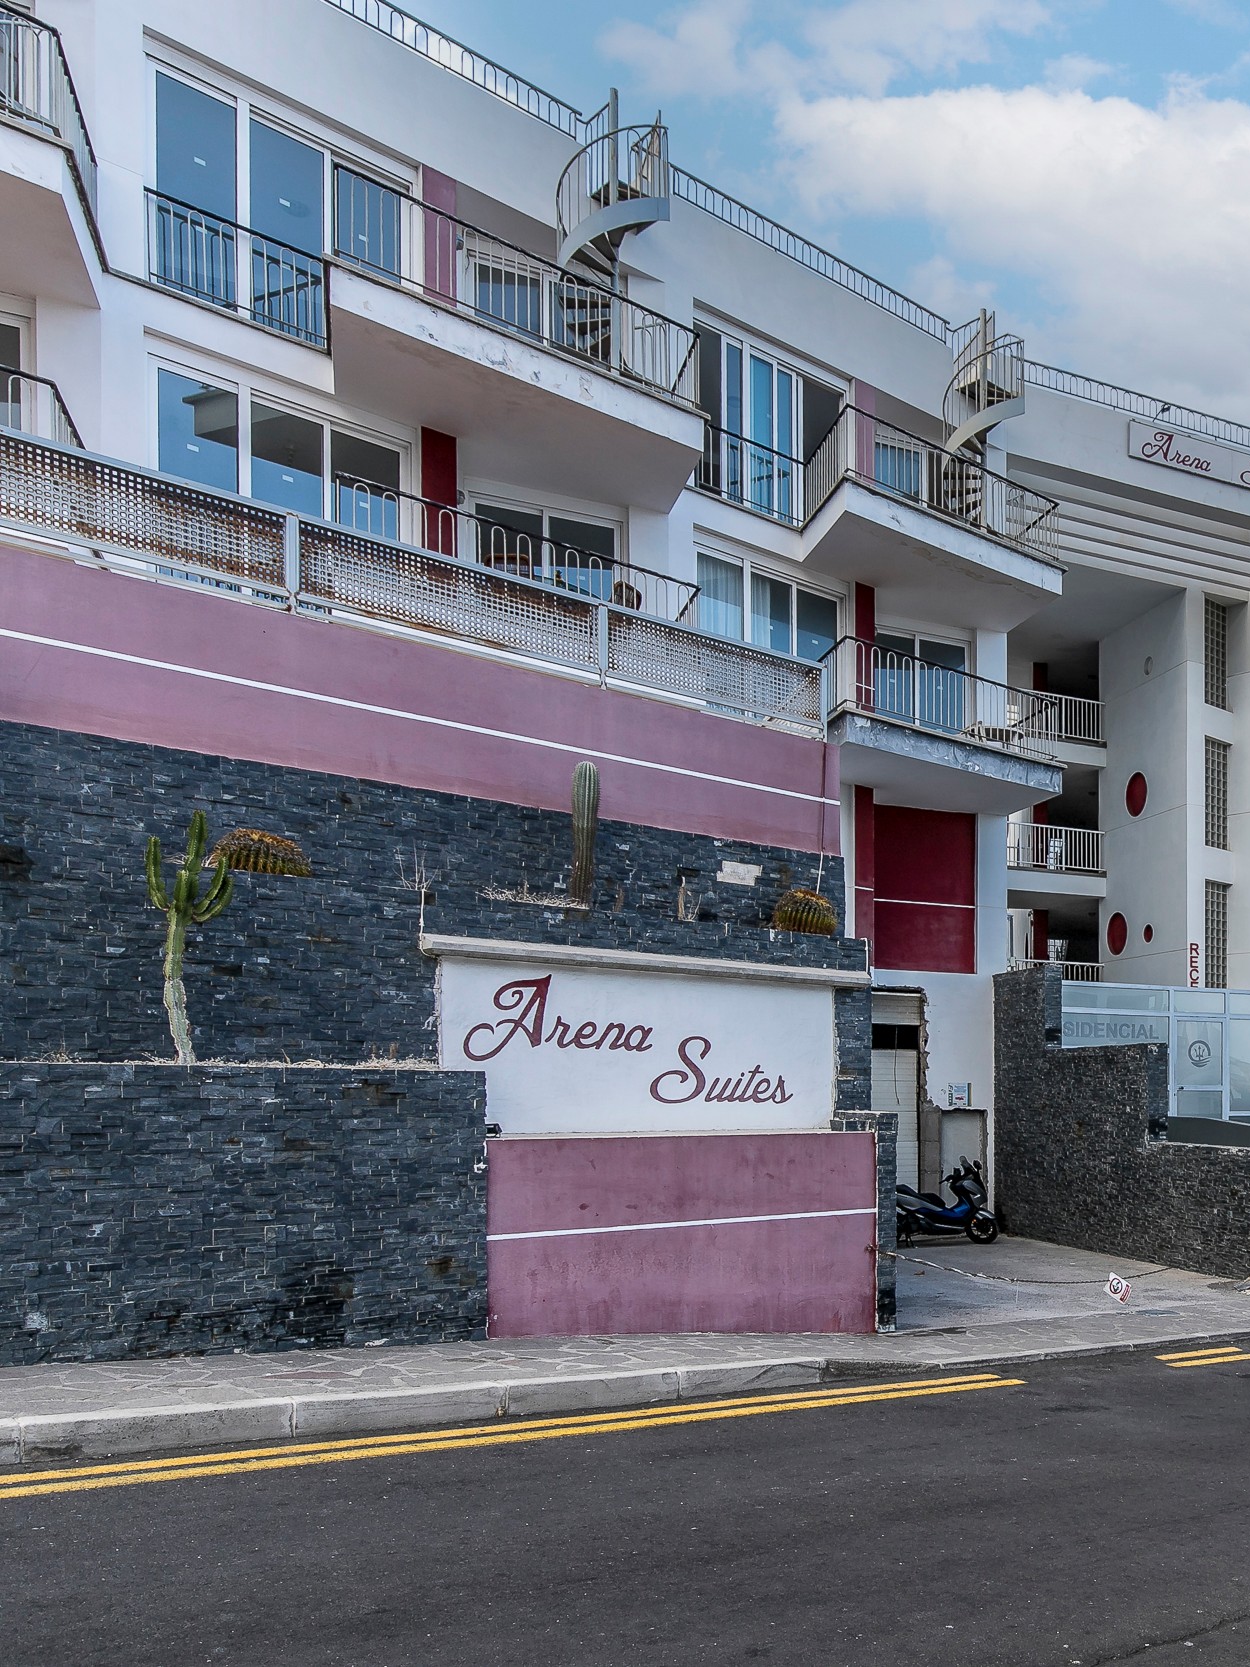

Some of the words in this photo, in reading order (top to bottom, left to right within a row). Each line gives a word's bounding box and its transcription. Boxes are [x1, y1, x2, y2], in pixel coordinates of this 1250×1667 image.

[1141, 431, 1212, 473] Arena
[462, 973, 654, 1063] Arena
[649, 1035, 794, 1105] Suites
[1063, 1021, 1160, 1040] SIDENCIAL
